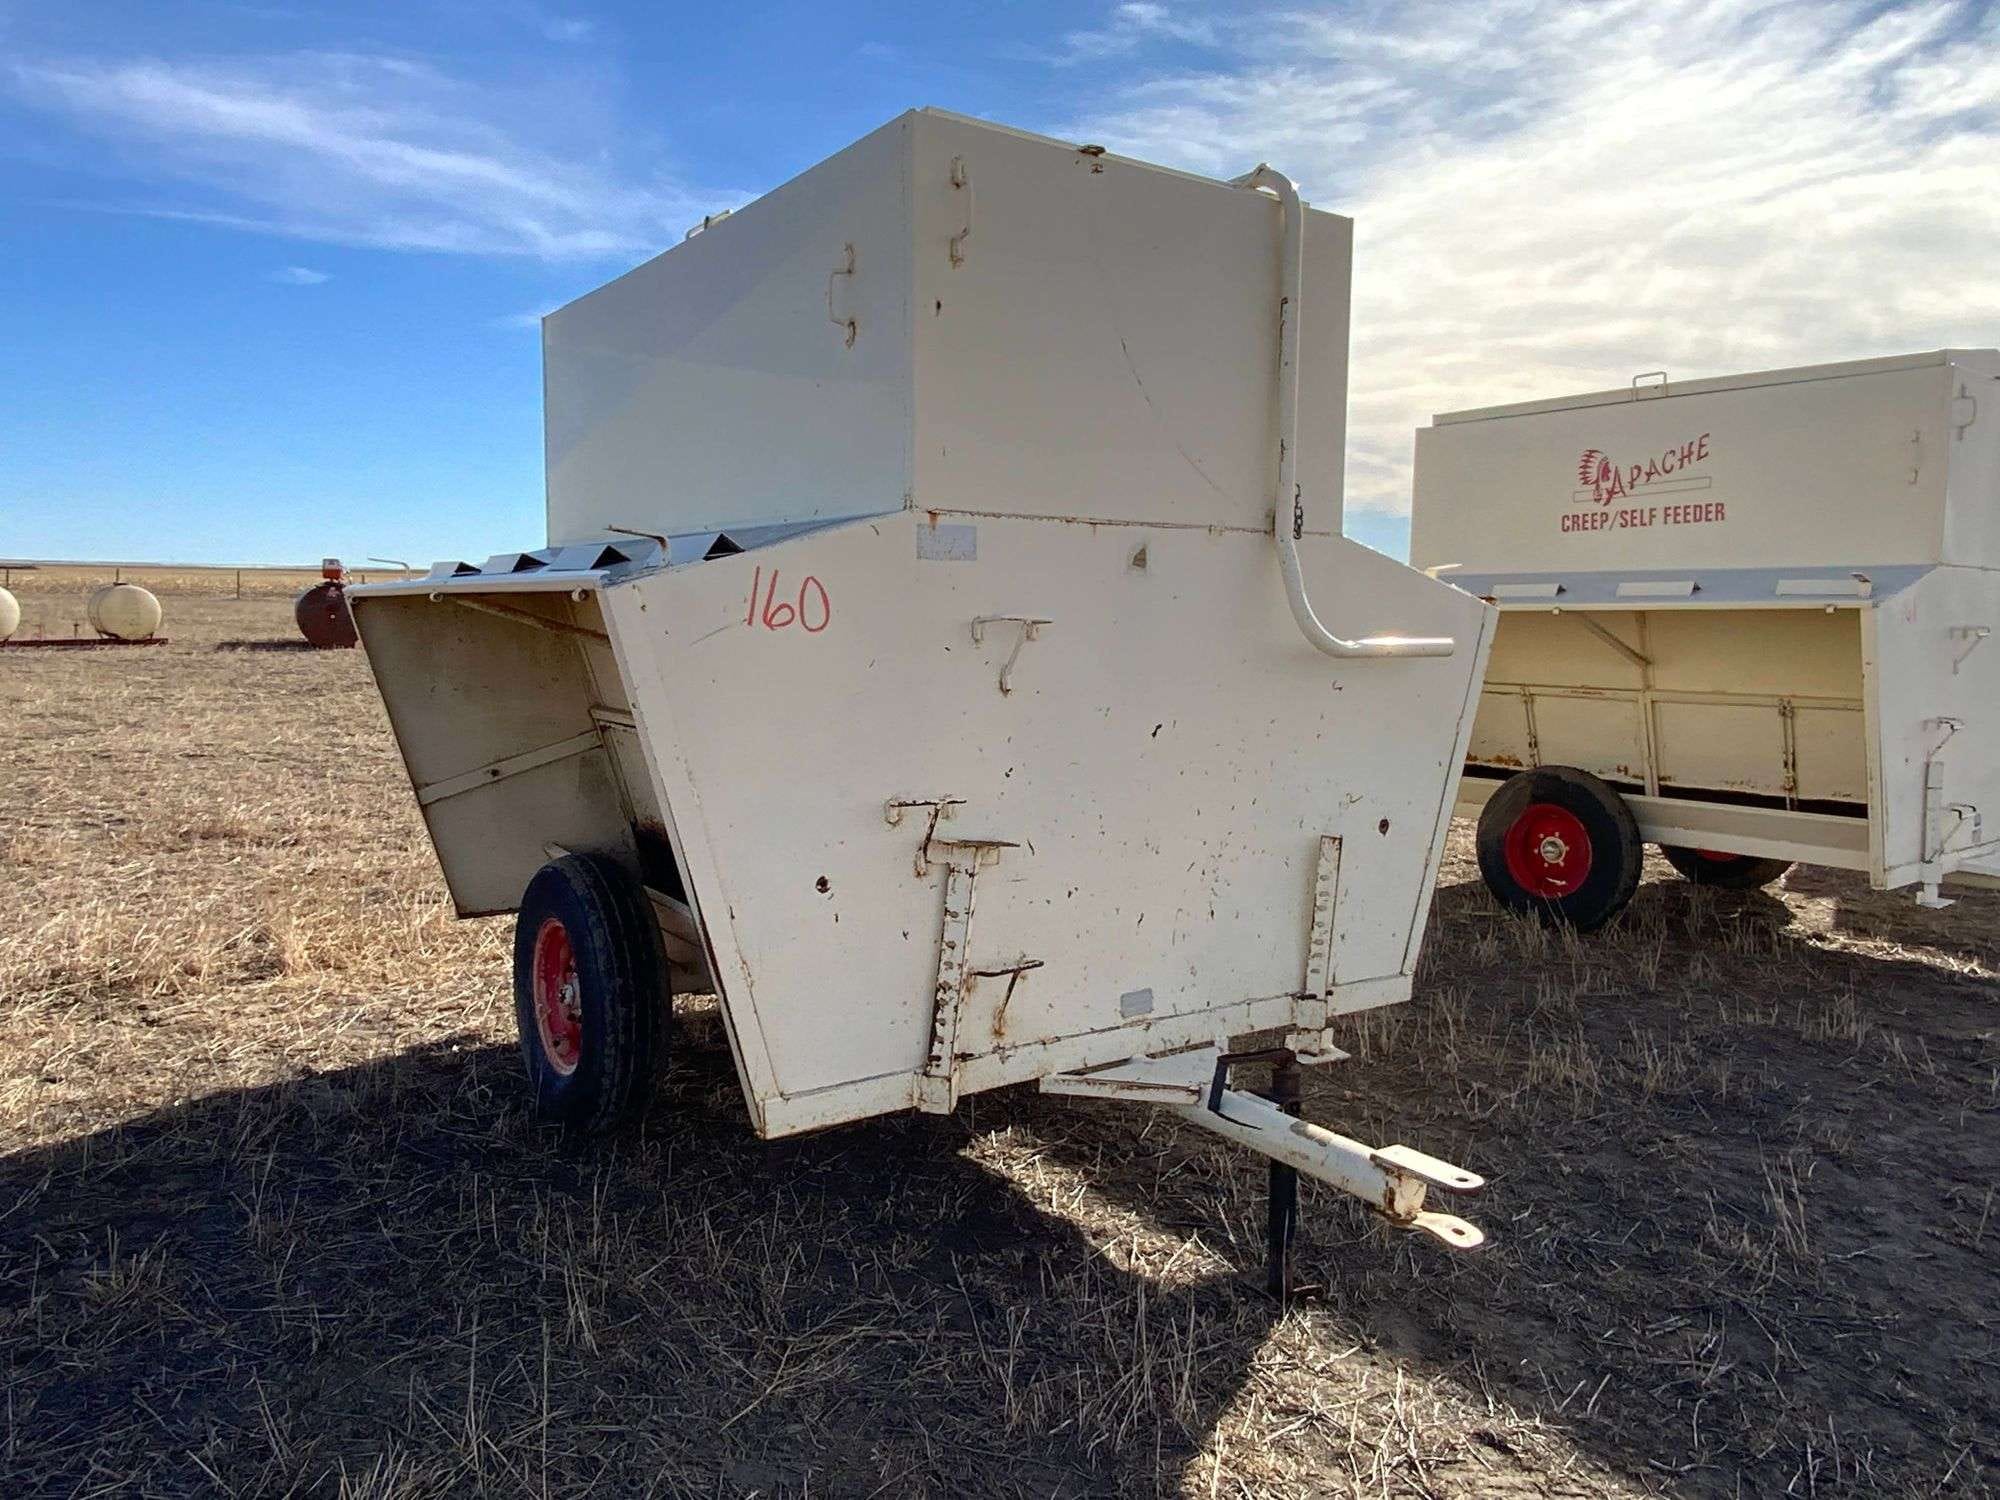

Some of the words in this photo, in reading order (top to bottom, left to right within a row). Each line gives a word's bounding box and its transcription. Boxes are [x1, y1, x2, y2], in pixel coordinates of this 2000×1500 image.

[1602, 433, 1710, 506] APACHE
[1561, 508, 1657, 533] CREEP/SELF
[1663, 502, 1725, 525] FEEDER
[747, 565, 830, 633] 160
